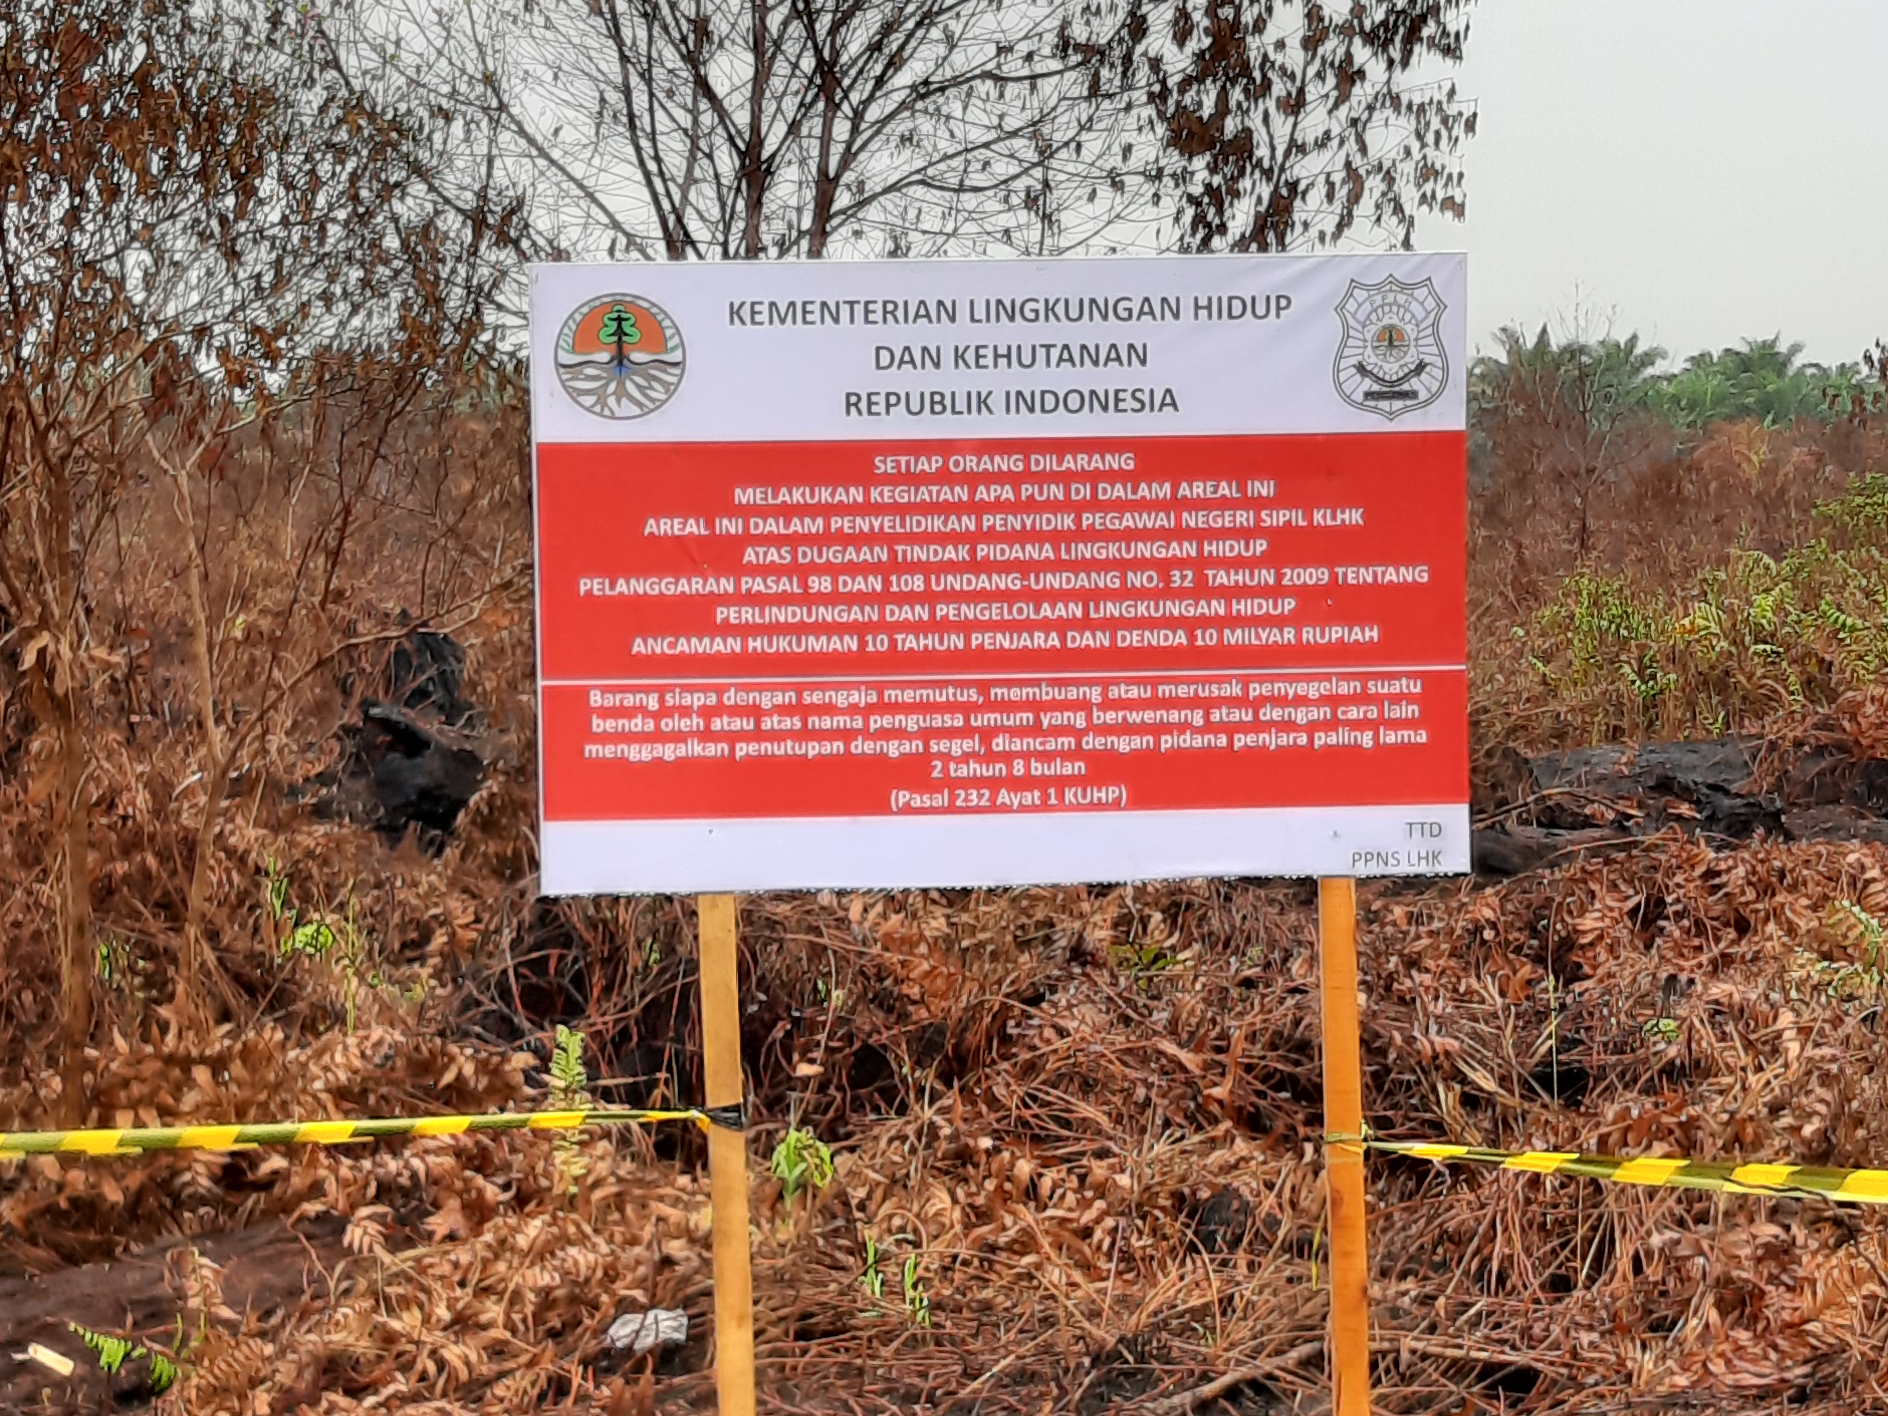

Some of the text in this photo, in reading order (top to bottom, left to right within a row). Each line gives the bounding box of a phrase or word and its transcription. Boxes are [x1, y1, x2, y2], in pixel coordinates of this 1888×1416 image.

[728, 294, 1292, 326] KEMENTERIAN LINGKUNGAN HIDUP
[874, 342, 1148, 371] DAN KEHUTANAN
[845, 387, 1180, 417] REPUBLIK INDONESIA
[873, 452, 1135, 475] SETIAP ORANG DILARANG
[734, 479, 1275, 505] MELAKUKAN KEGIATAN APA PUN DI DALAM AREAL INI
[643, 507, 1364, 537] AREAL INI DALAM PENYELIDIKAN PENYIDIK PEGAWAI NEGERI SIPIL KLHK
[742, 538, 1268, 565] ATAS DUGAAN TINDAK PIDANA LINGKUNGAN HIDUP
[579, 565, 1429, 597] PELANGGARAN PASAL 98 DAN 108 UNDANG-UNDANG NO. 32 TAHUN 2009 TENTANG
[716, 597, 1297, 625] PERLINDUNGAN DAN PENGELOLAAN LINGKUNGAN HIDUP
[631, 624, 1379, 655] ANCAMAN HUKUMAN 10 TAHUN PENJARA DAN DENDA 10 MILYAR RUPIAH
[588, 688, 660, 712] Barang
[664, 686, 719, 712] siapa
[722, 686, 797, 710] dengan
[801, 685, 879, 709] sengaja
[883, 684, 984, 705] memutus,
[1107, 682, 1152, 700] atau
[1156, 678, 1243, 699] merusak
[1366, 676, 1423, 694] suatu
[591, 712, 656, 734] benda
[710, 714, 755, 732] atau
[760, 713, 803, 731] atas
[807, 714, 865, 730] nama
[869, 713, 965, 734] penguasa
[969, 711, 1035, 728] umum
[1039, 710, 1087, 730] yang
[1092, 704, 1205, 727] berwenang
[1209, 704, 1254, 723] atau
[1258, 702, 1332, 725] dengan
[1336, 705, 1378, 720] cara
[1383, 699, 1420, 720] lain
[583, 725, 1428, 763] menggagalkan penutupan dengan segel, diancam dengan pidana penjara paling lama
[930, 756, 1086, 778] 2 tahun 8 bulan
[890, 783, 1128, 812] (Pasal 232 Ayat 1 KUHP)
[1406, 821, 1442, 838] TTD
[1352, 850, 1442, 868] PPNS LHK
